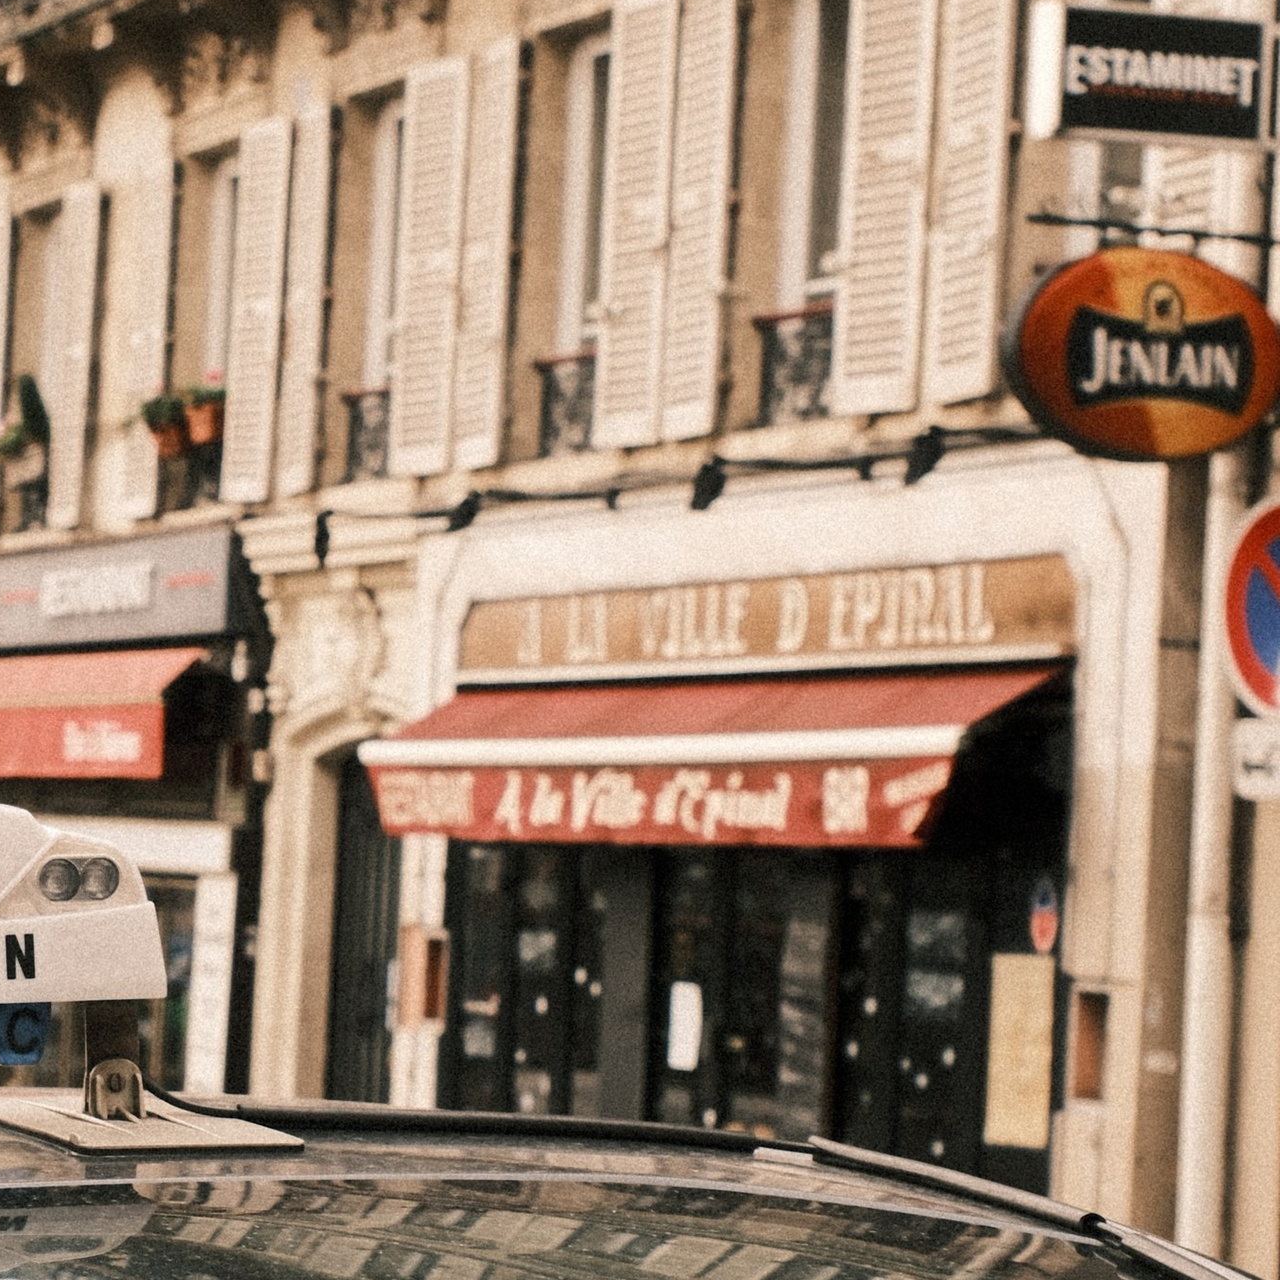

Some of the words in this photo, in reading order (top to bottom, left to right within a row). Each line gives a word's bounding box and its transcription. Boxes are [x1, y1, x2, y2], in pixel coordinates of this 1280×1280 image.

[1066, 44, 1259, 108] ESTAMINET
[1079, 326, 1239, 394] JENLAIN
[640, 581, 752, 659] VILLE
[6, 1008, 40, 1055] C
